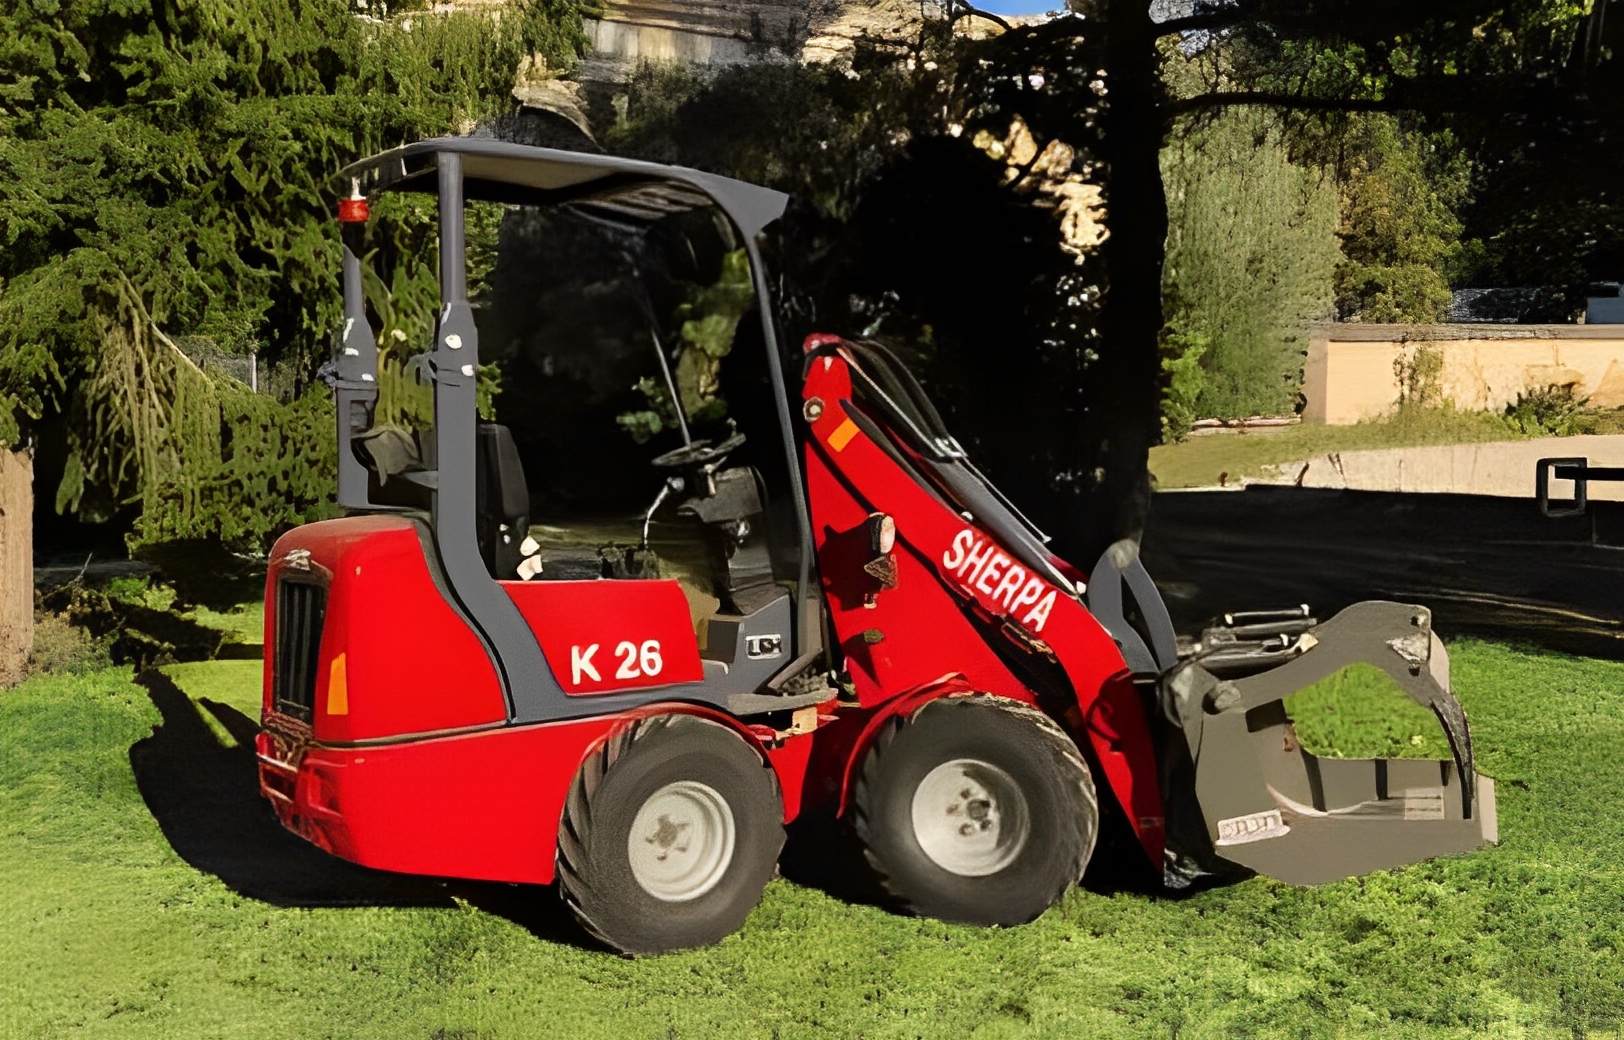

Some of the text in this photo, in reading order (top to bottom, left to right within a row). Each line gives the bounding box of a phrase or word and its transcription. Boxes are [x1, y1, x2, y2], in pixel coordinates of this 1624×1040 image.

[943, 529, 1057, 632] SHERPA
[571, 639, 663, 685] K 26
